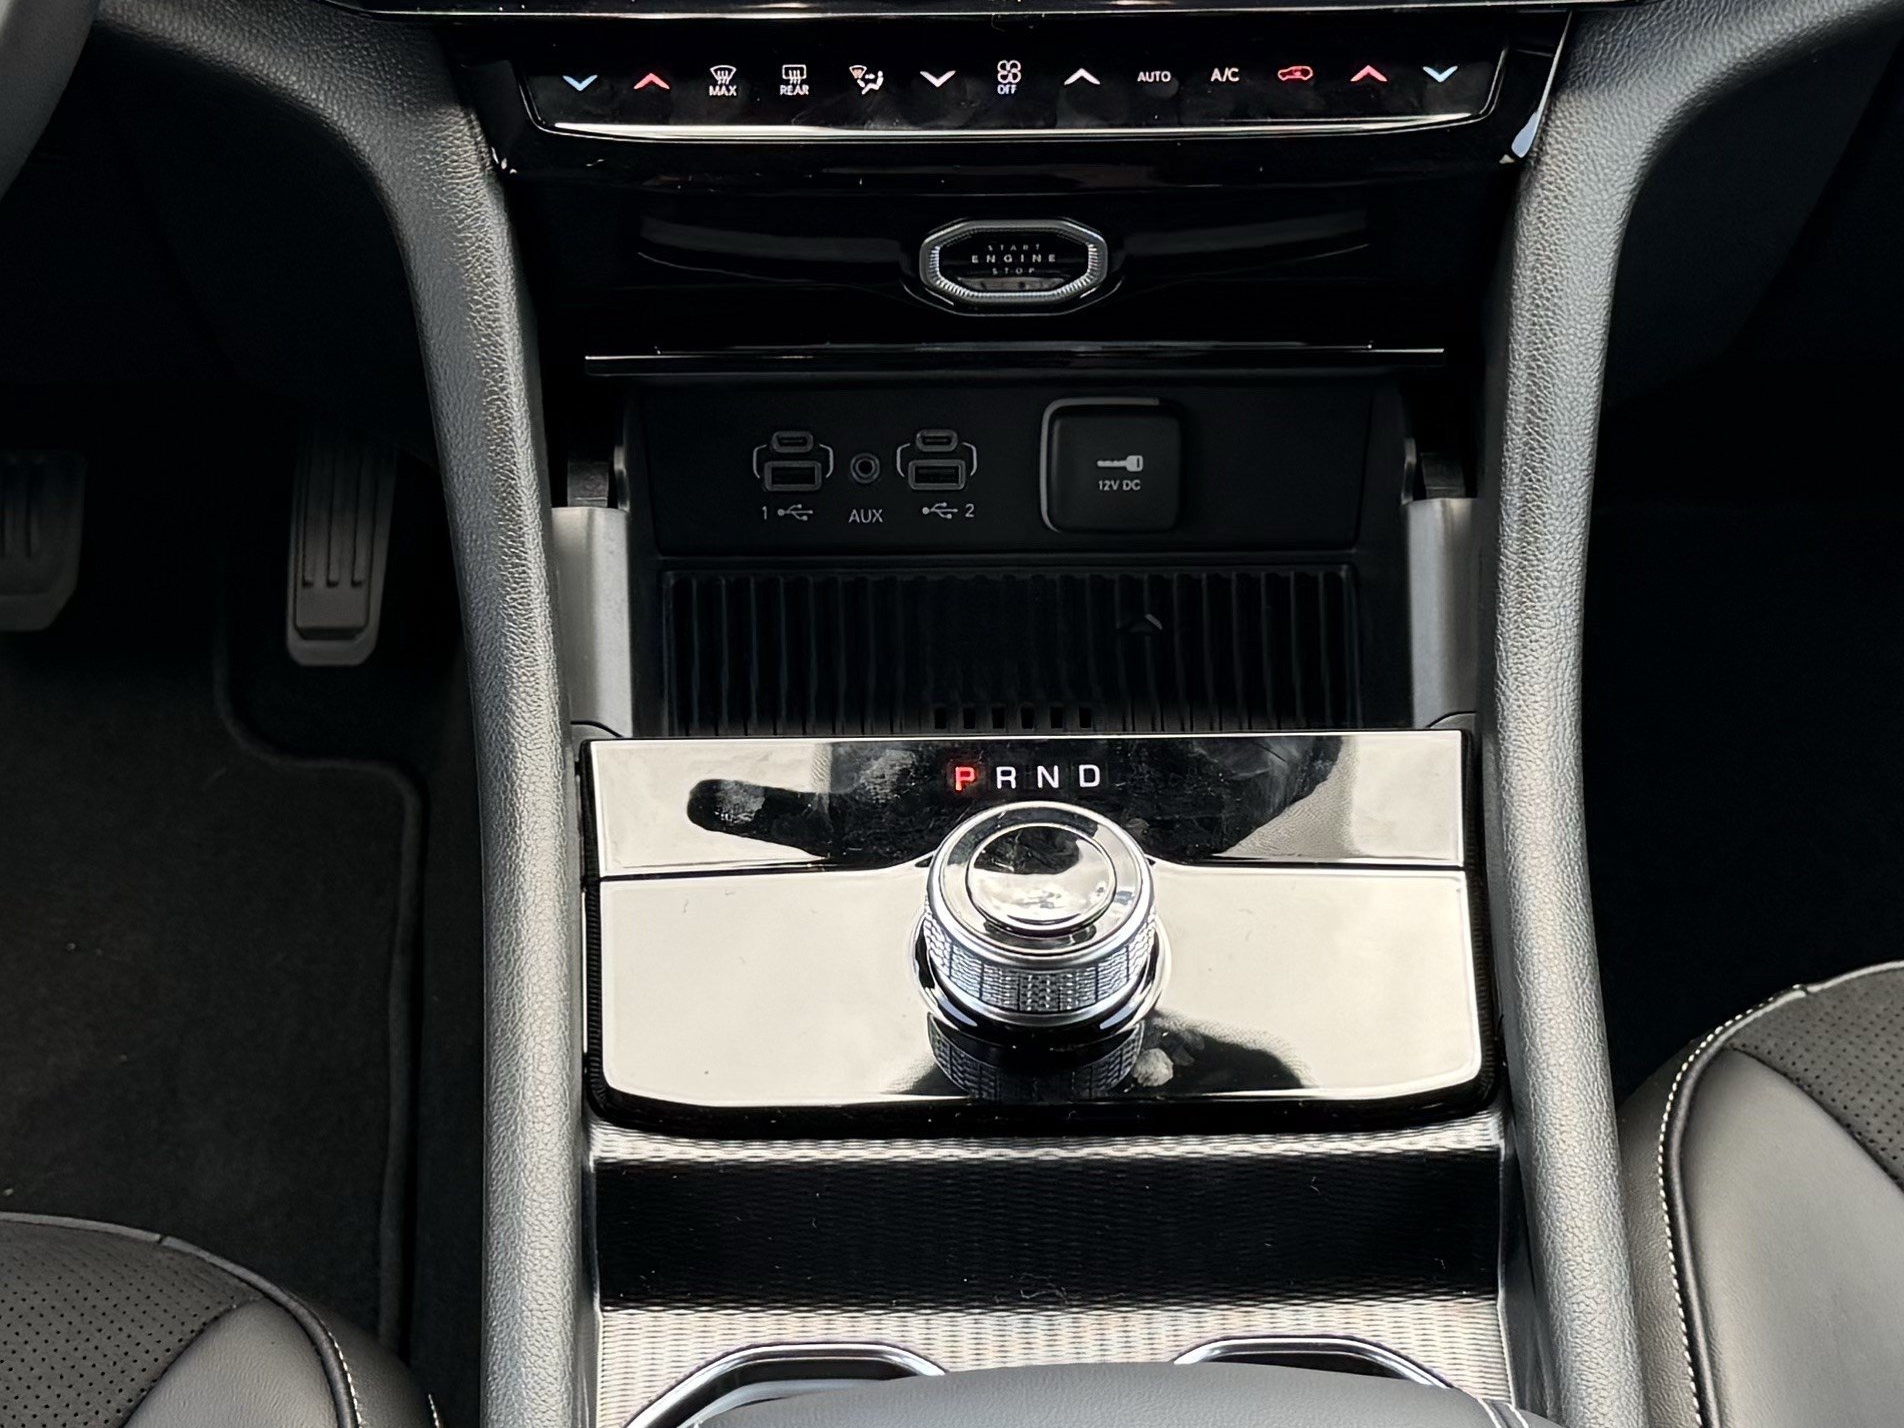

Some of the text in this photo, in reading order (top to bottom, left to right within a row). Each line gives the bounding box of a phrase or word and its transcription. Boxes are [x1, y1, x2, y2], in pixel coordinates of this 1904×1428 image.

[1137, 71, 1172, 82] AUTO
[1210, 67, 1240, 82] A/C
[709, 84, 737, 97] MAX
[779, 84, 809, 96] REAR
[998, 83, 1017, 95] OFF
[971, 254, 1056, 263] ENGINE
[1098, 480, 1141, 491] 12V DC
[849, 510, 883, 524] AUX
[965, 505, 975, 518] 2
[955, 764, 1101, 790] P R N D
